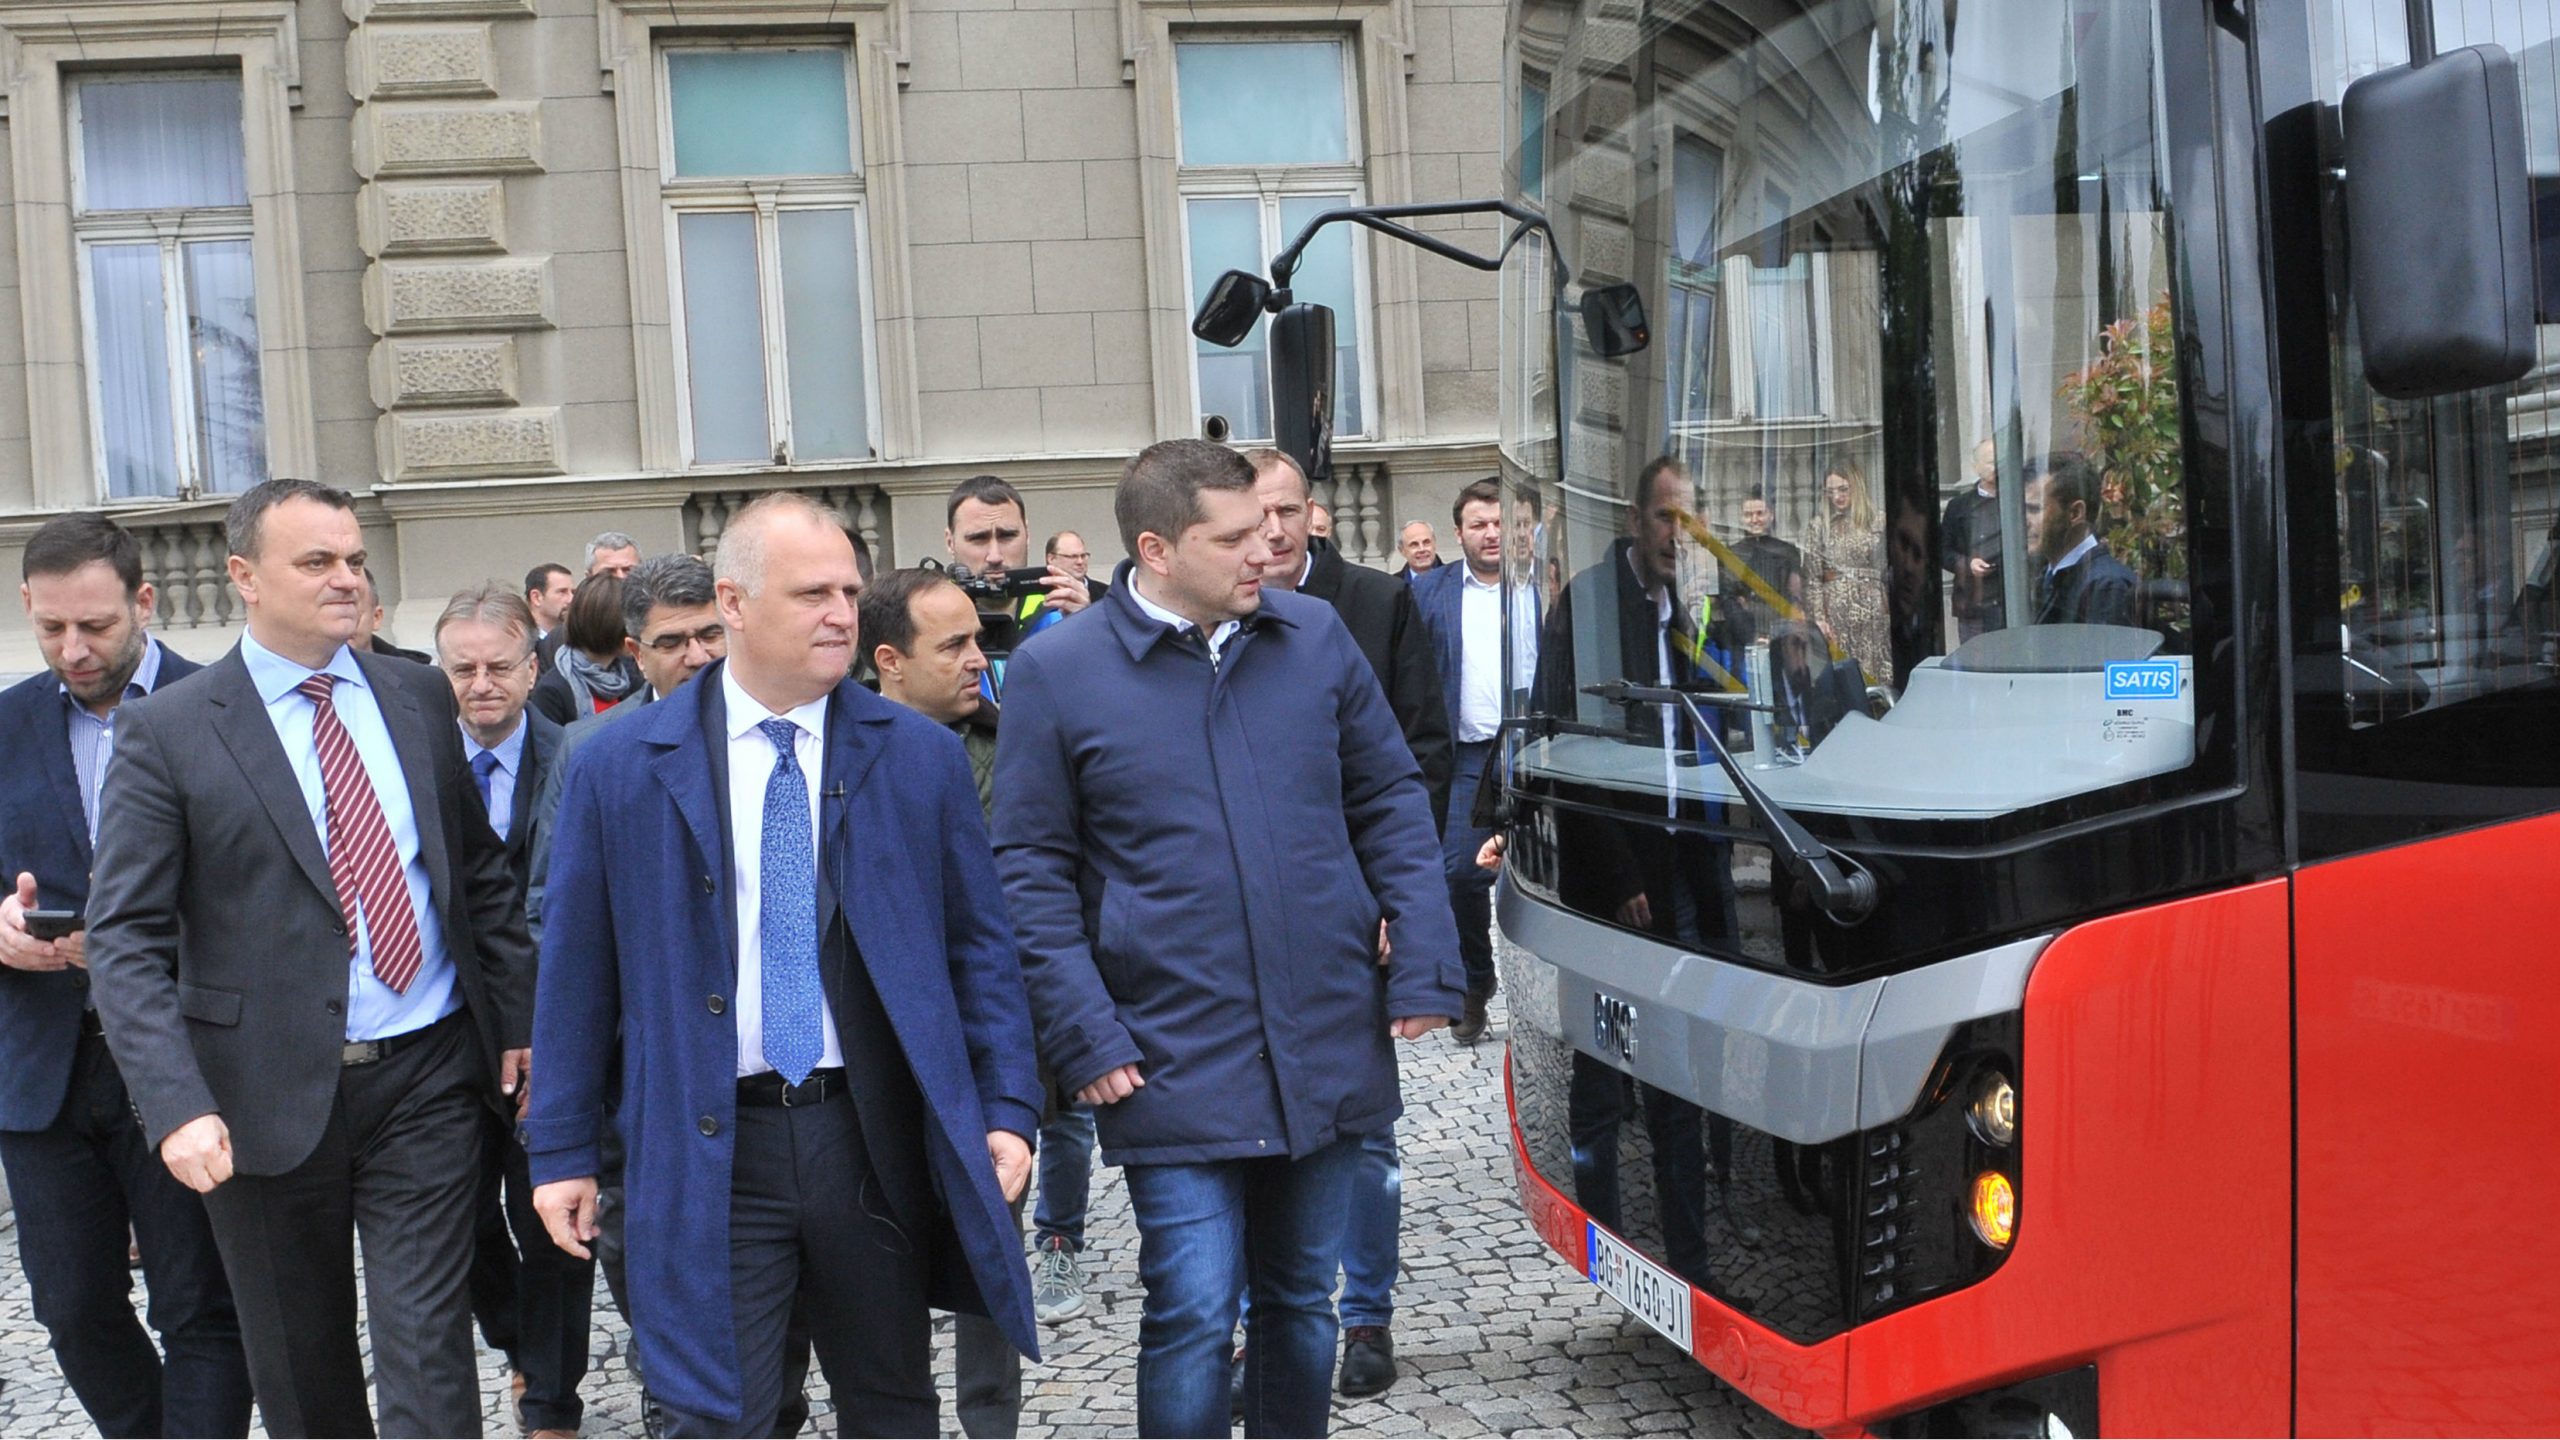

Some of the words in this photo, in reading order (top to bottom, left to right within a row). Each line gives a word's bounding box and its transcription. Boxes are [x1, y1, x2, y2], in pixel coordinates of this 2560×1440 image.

[2114, 671, 2172, 690] SATIŞ
[2117, 709, 2134, 717] BMC
[1597, 1238, 1614, 1288] BG
